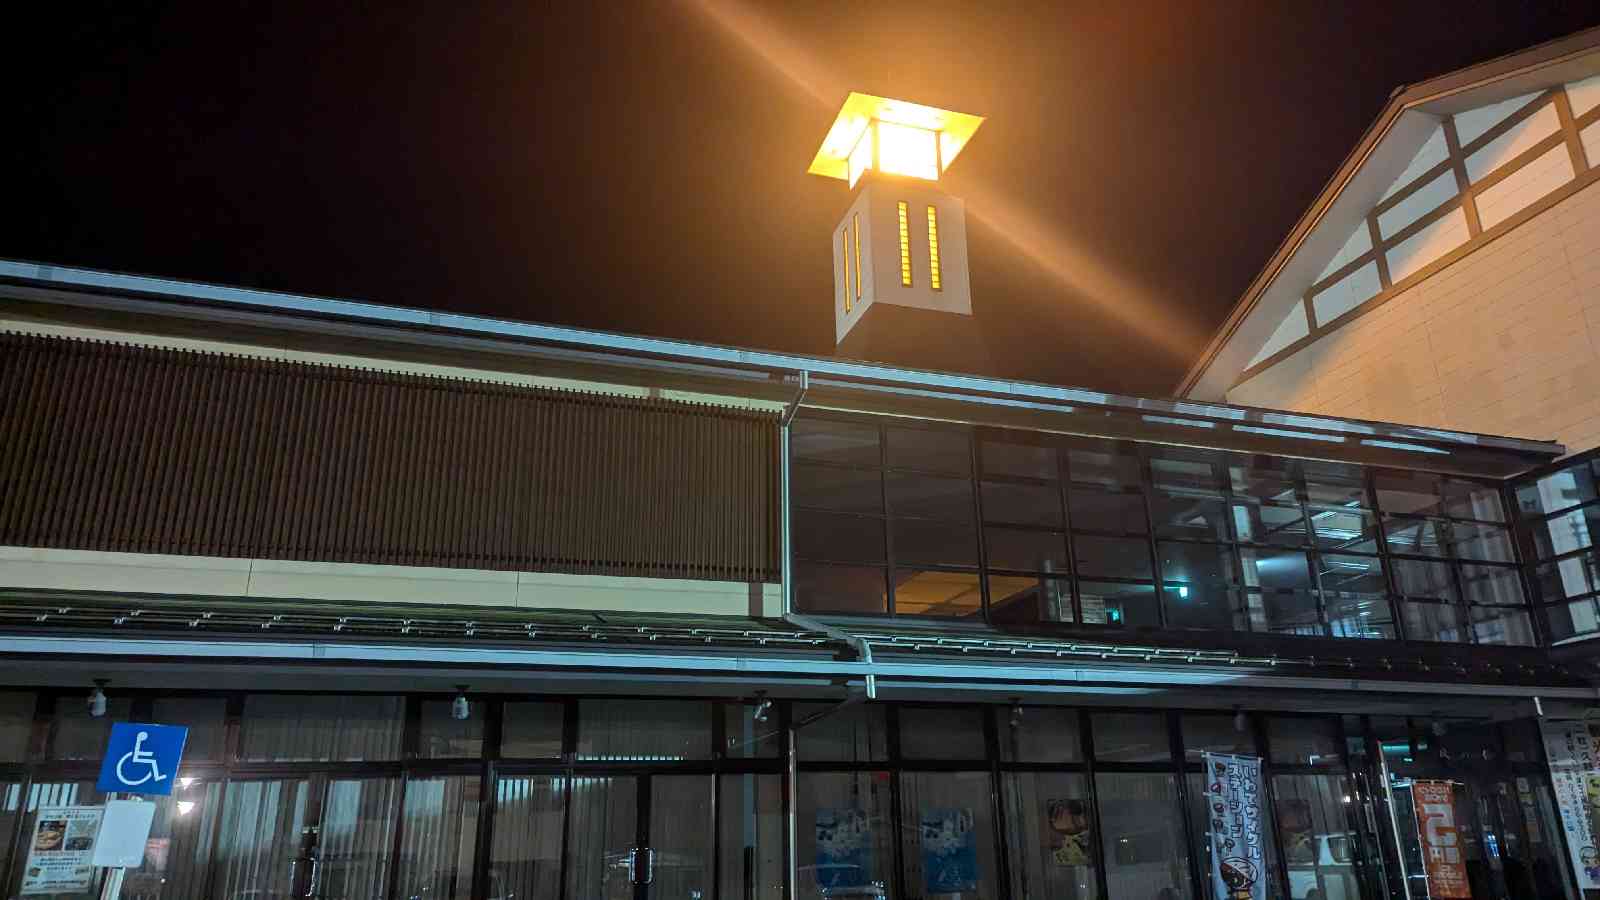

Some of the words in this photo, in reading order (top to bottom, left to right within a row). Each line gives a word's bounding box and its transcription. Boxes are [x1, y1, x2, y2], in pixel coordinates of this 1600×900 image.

[1228, 761, 1243, 839] ステーション
